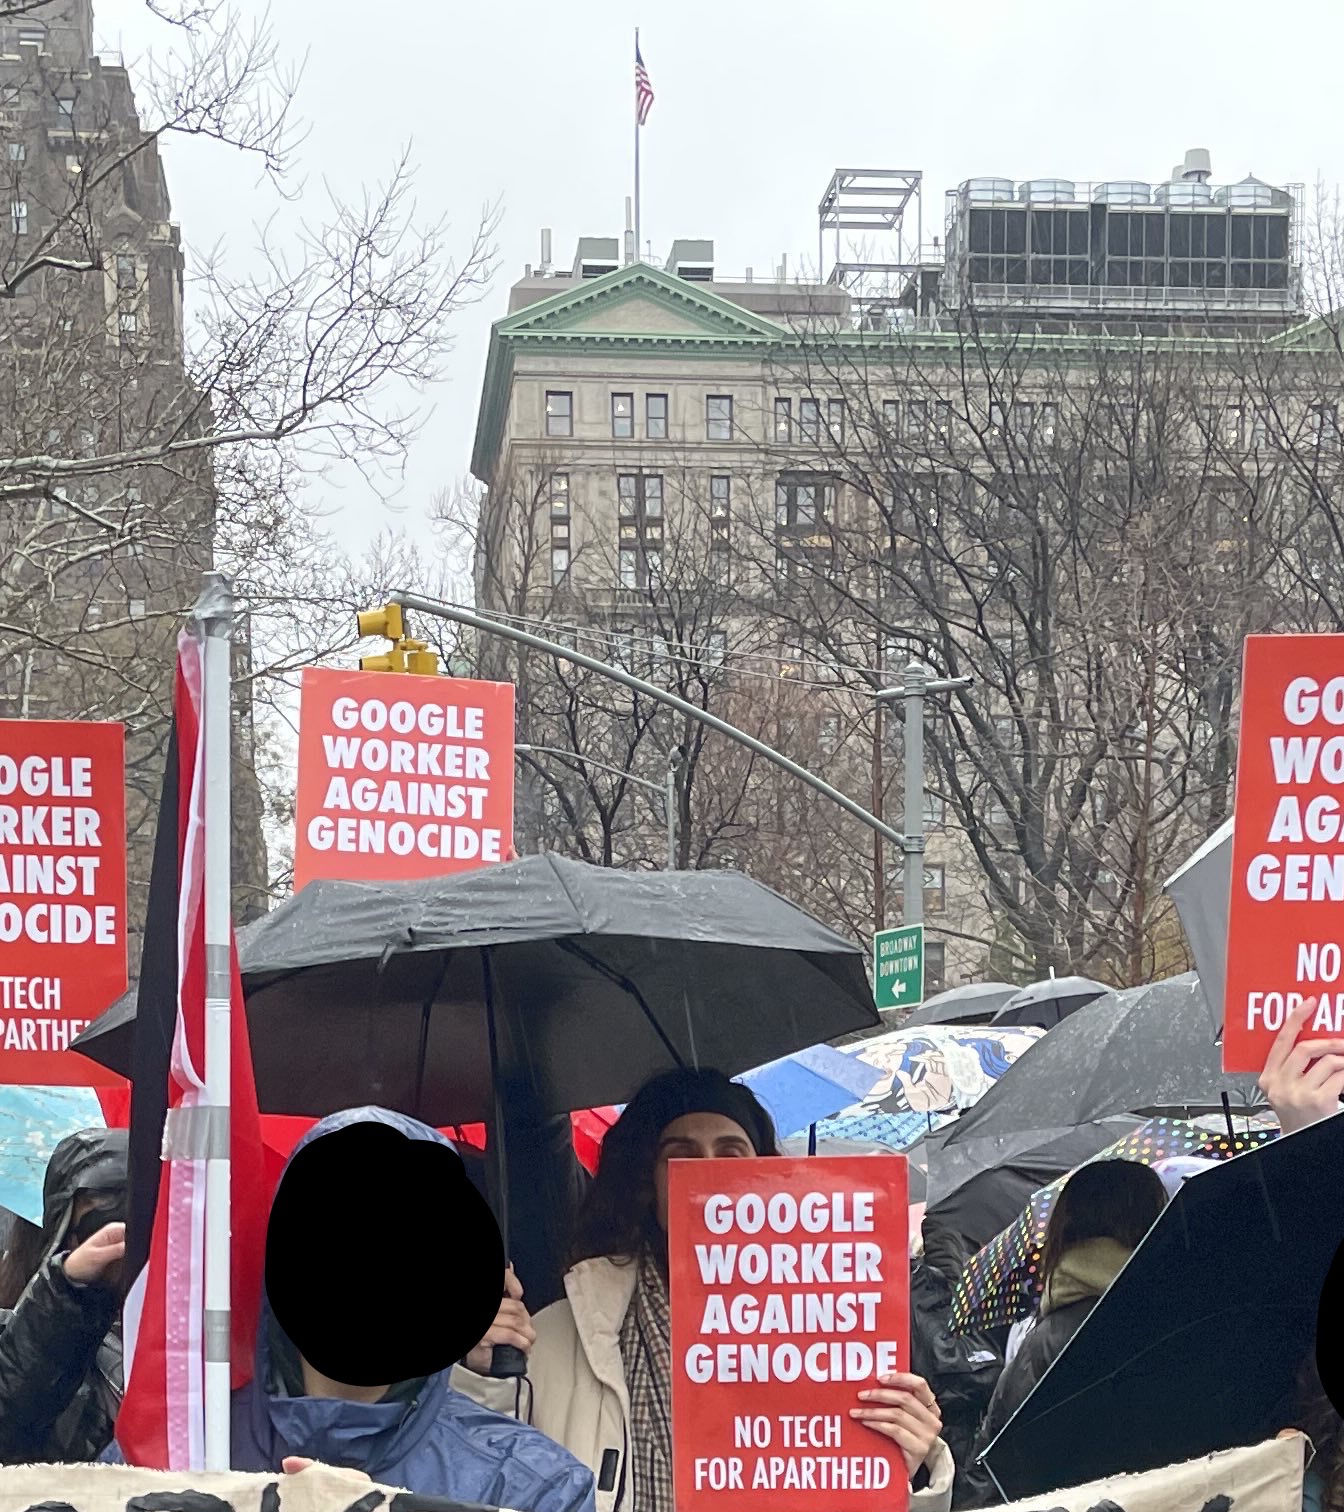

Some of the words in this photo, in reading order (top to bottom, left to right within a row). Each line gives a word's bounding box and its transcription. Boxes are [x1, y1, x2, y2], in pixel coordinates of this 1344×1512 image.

[332, 696, 484, 740] GOOGLE
[322, 735, 491, 781] WORKER
[322, 776, 489, 820] AGAINST
[307, 815, 501, 862] GENOCIDE
[879, 935, 917, 957] BROADWAY
[879, 955, 918, 978] DOWNTOWN
[1296, 943, 1341, 983] NO
[0, 976, 61, 1010] TECH
[704, 1191, 874, 1234] GOOGLE
[695, 1242, 883, 1285] WORKER
[700, 1292, 881, 1335] AGAINST
[685, 1340, 897, 1384] GENOCIDE
[734, 1416, 772, 1448] NO
[779, 1415, 841, 1448] TECH
[694, 1457, 744, 1490] FOR
[752, 1457, 890, 1490] APARTHEID
